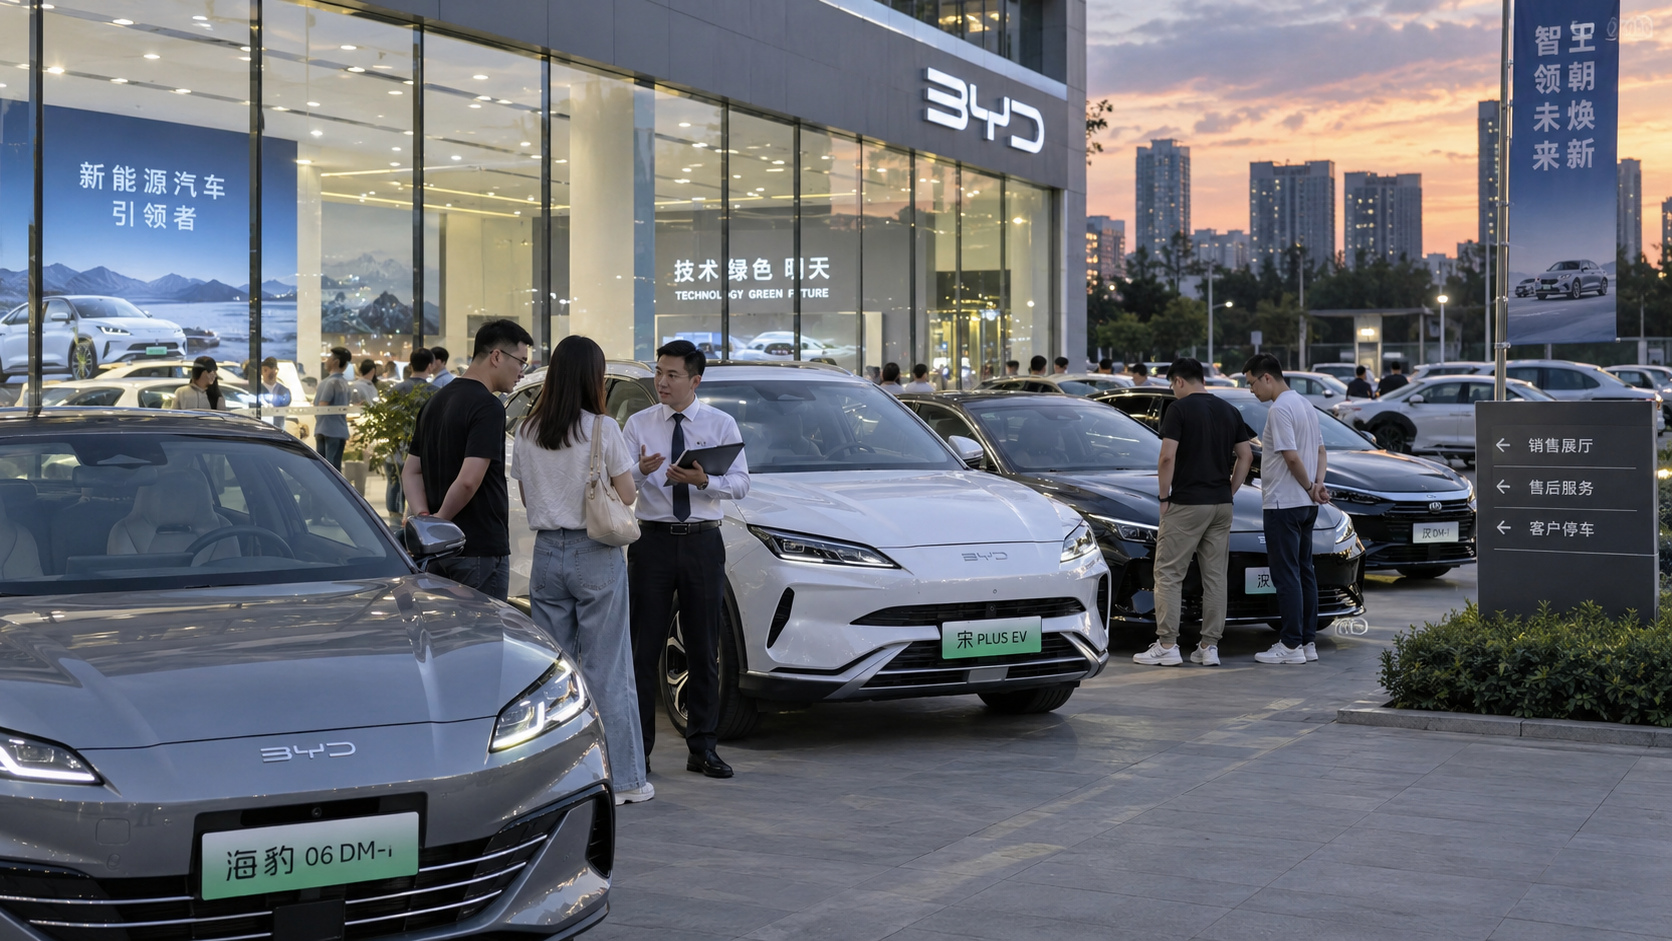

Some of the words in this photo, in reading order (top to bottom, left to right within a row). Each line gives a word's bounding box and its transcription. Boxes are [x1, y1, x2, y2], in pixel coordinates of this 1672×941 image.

[1532, 25, 1562, 171] 智领未来
[1567, 22, 1596, 170] 王朝焕新
[926, 66, 1045, 154] BYD
[79, 161, 226, 200] 新能源汽车
[112, 200, 197, 232] 引领者
[674, 258, 719, 283] 技术
[728, 257, 773, 282] 绿色
[784, 256, 830, 281] 明天
[675, 289, 744, 300] TECHNOLGY
[748, 288, 783, 299] GREEN
[788, 287, 829, 299] FTURE
[1528, 437, 1594, 454] 销售展厅
[1528, 479, 1594, 496] 售后服务
[1529, 520, 1595, 538] 客户停车
[961, 551, 1008, 562] BYD
[957, 630, 973, 649] 宋
[977, 631, 1009, 645] PLUS
[1012, 630, 1028, 644] EV
[260, 741, 356, 763] BYD
[226, 844, 294, 881] 海豹
[305, 845, 334, 867] 06
[340, 840, 393, 863] DM-i
